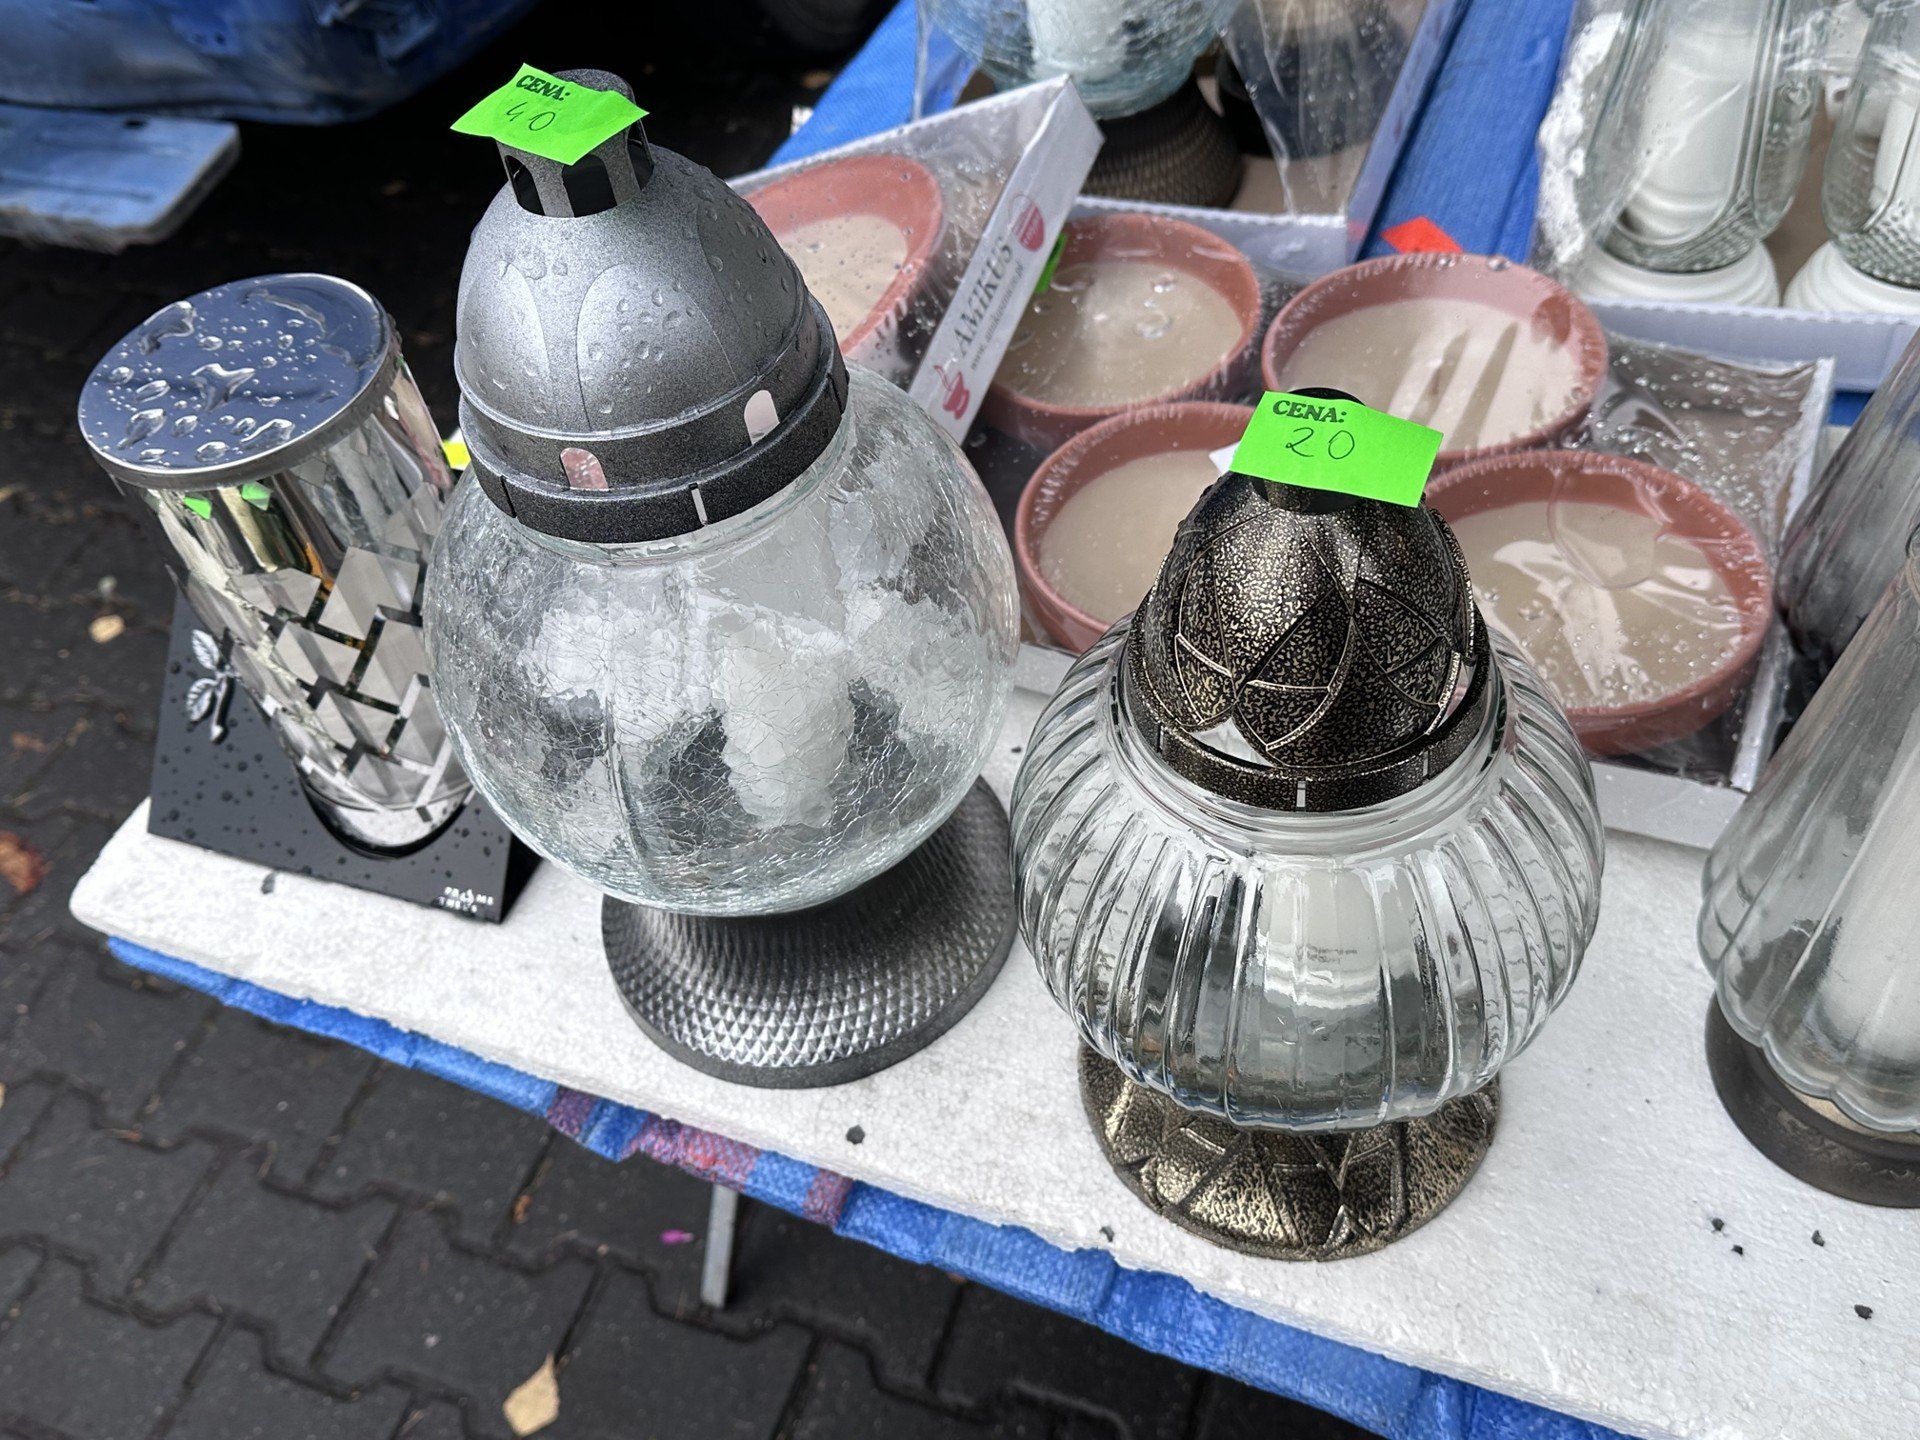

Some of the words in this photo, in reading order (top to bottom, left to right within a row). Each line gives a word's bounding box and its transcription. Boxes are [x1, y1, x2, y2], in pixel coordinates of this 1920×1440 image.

[515, 74, 571, 101] CENA:
[505, 101, 556, 132] 40
[1272, 400, 1347, 423] CENA:
[1285, 426, 1356, 460] 20
